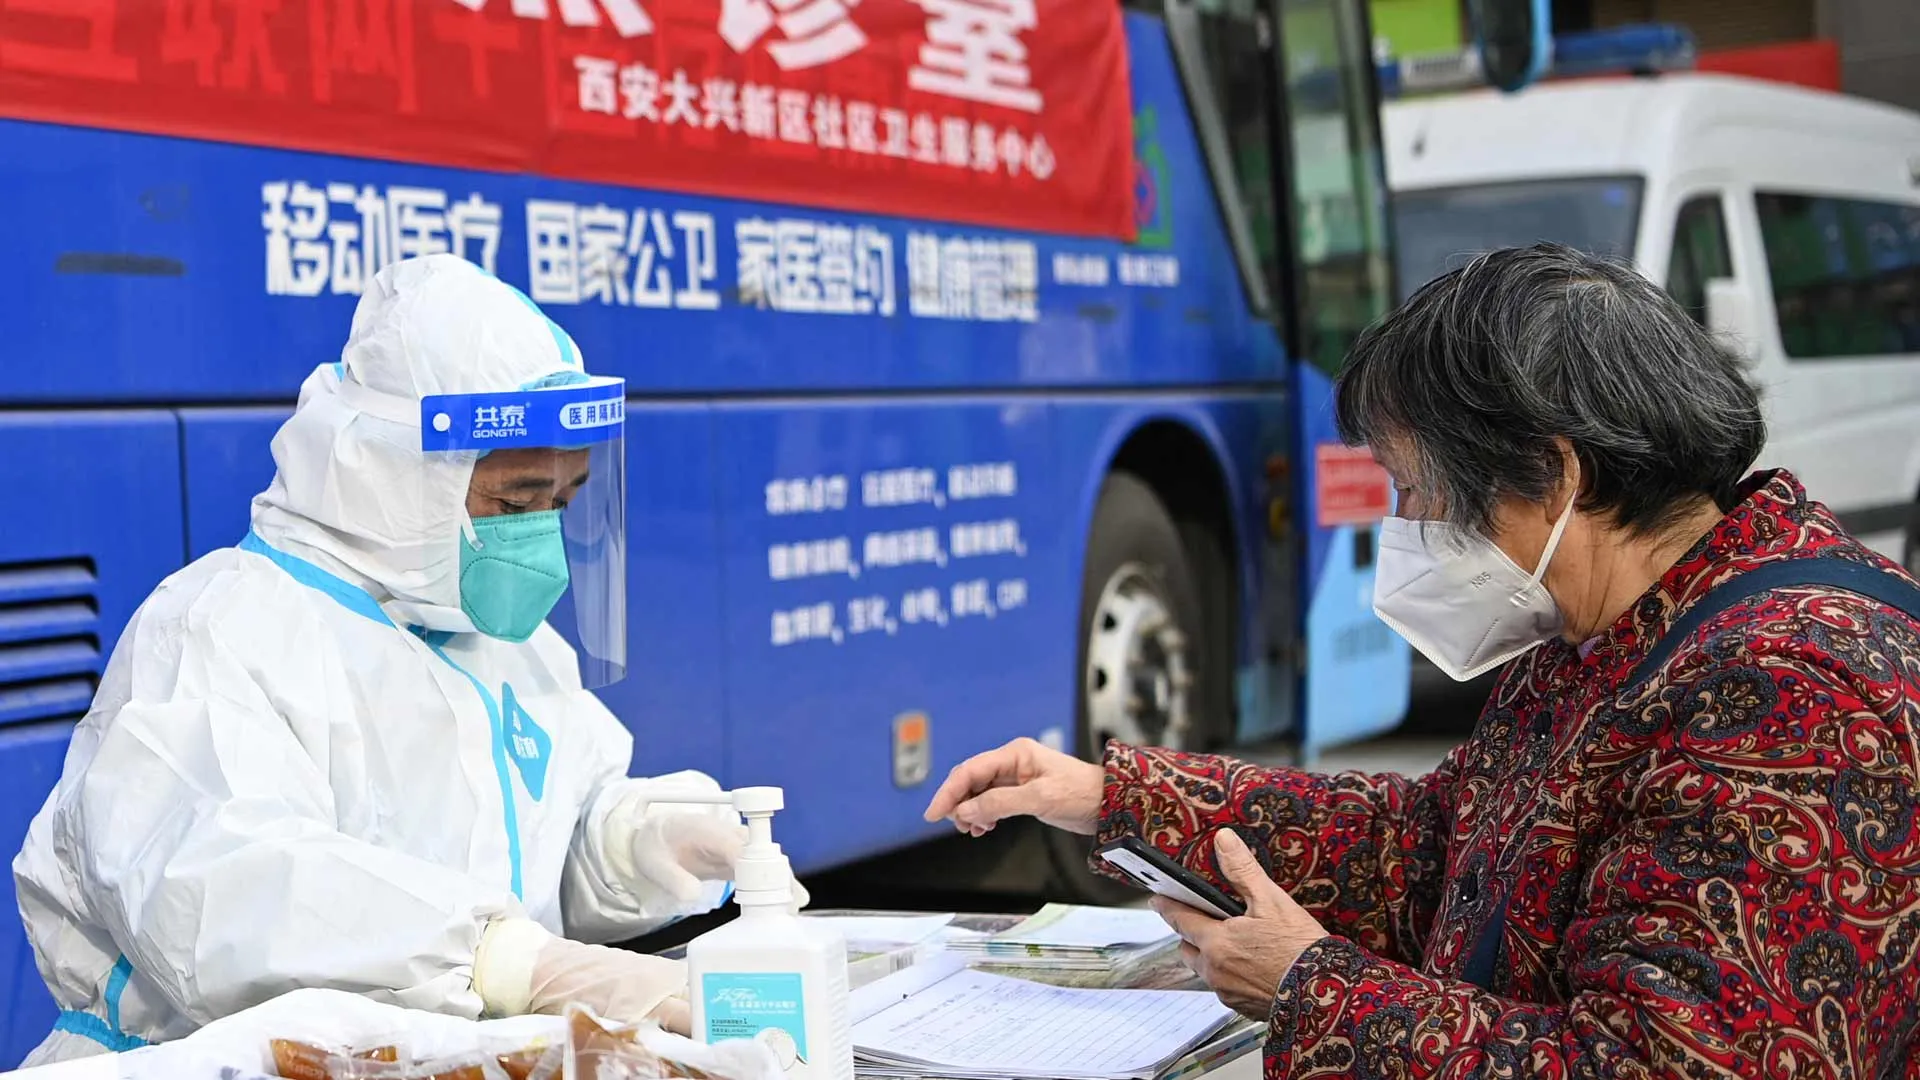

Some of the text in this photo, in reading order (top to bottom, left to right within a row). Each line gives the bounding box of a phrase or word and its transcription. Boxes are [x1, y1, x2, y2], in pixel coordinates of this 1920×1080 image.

[574, 55, 1056, 181] 西安大兴新区社区卫生服务中心
[261, 181, 501, 297] 移动医疗
[526, 199, 721, 310] 国家公卫
[735, 217, 895, 317] 家医签约
[474, 405, 525, 428] 共泰
[472, 428, 528, 439] GONGTAI
[1470, 571, 1492, 590] N95
